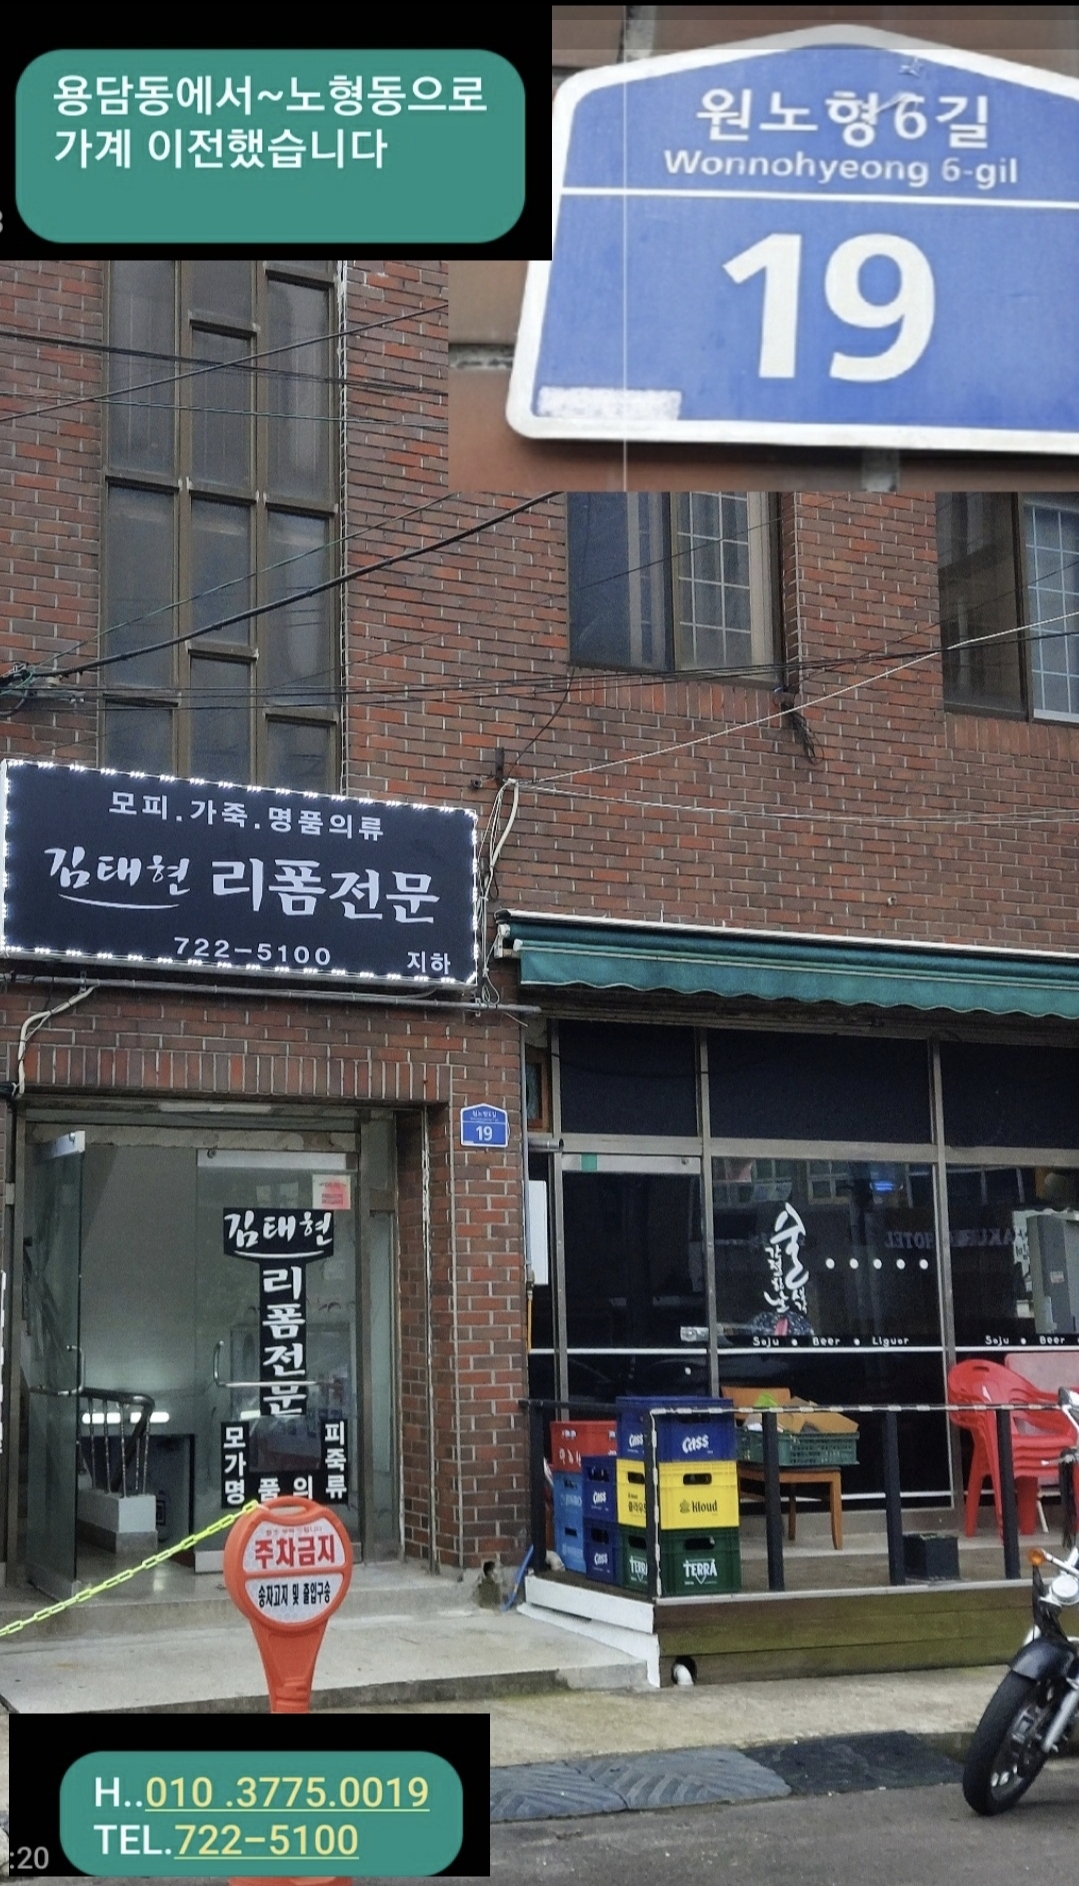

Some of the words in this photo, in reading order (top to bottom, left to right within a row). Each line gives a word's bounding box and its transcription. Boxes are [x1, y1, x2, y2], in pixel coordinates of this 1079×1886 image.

[697, 88, 990, 149] 원노형6길
[664, 149, 929, 187] Wonnohyeong
[941, 157, 1018, 190] 6-gil
[722, 233, 936, 382] 19
[44, 846, 191, 897] 김태현
[211, 858, 440, 925] 리폼전문
[173, 936, 331, 966] 722-5100
[406, 951, 451, 975] 지하
[475, 1125, 493, 1141] 19
[223, 1210, 333, 1248] 김태현
[261, 1266, 306, 1416] 리폼전문
[752, 1336, 780, 1348] Soju
[812, 1337, 841, 1346] Beer
[985, 1334, 1010, 1347] Soju
[1039, 1335, 1066, 1345] Beer
[255, 1534, 335, 1569] 주차금지
[683, 1558, 718, 1578] TERRA
[292, 1583, 300, 1606] 및
